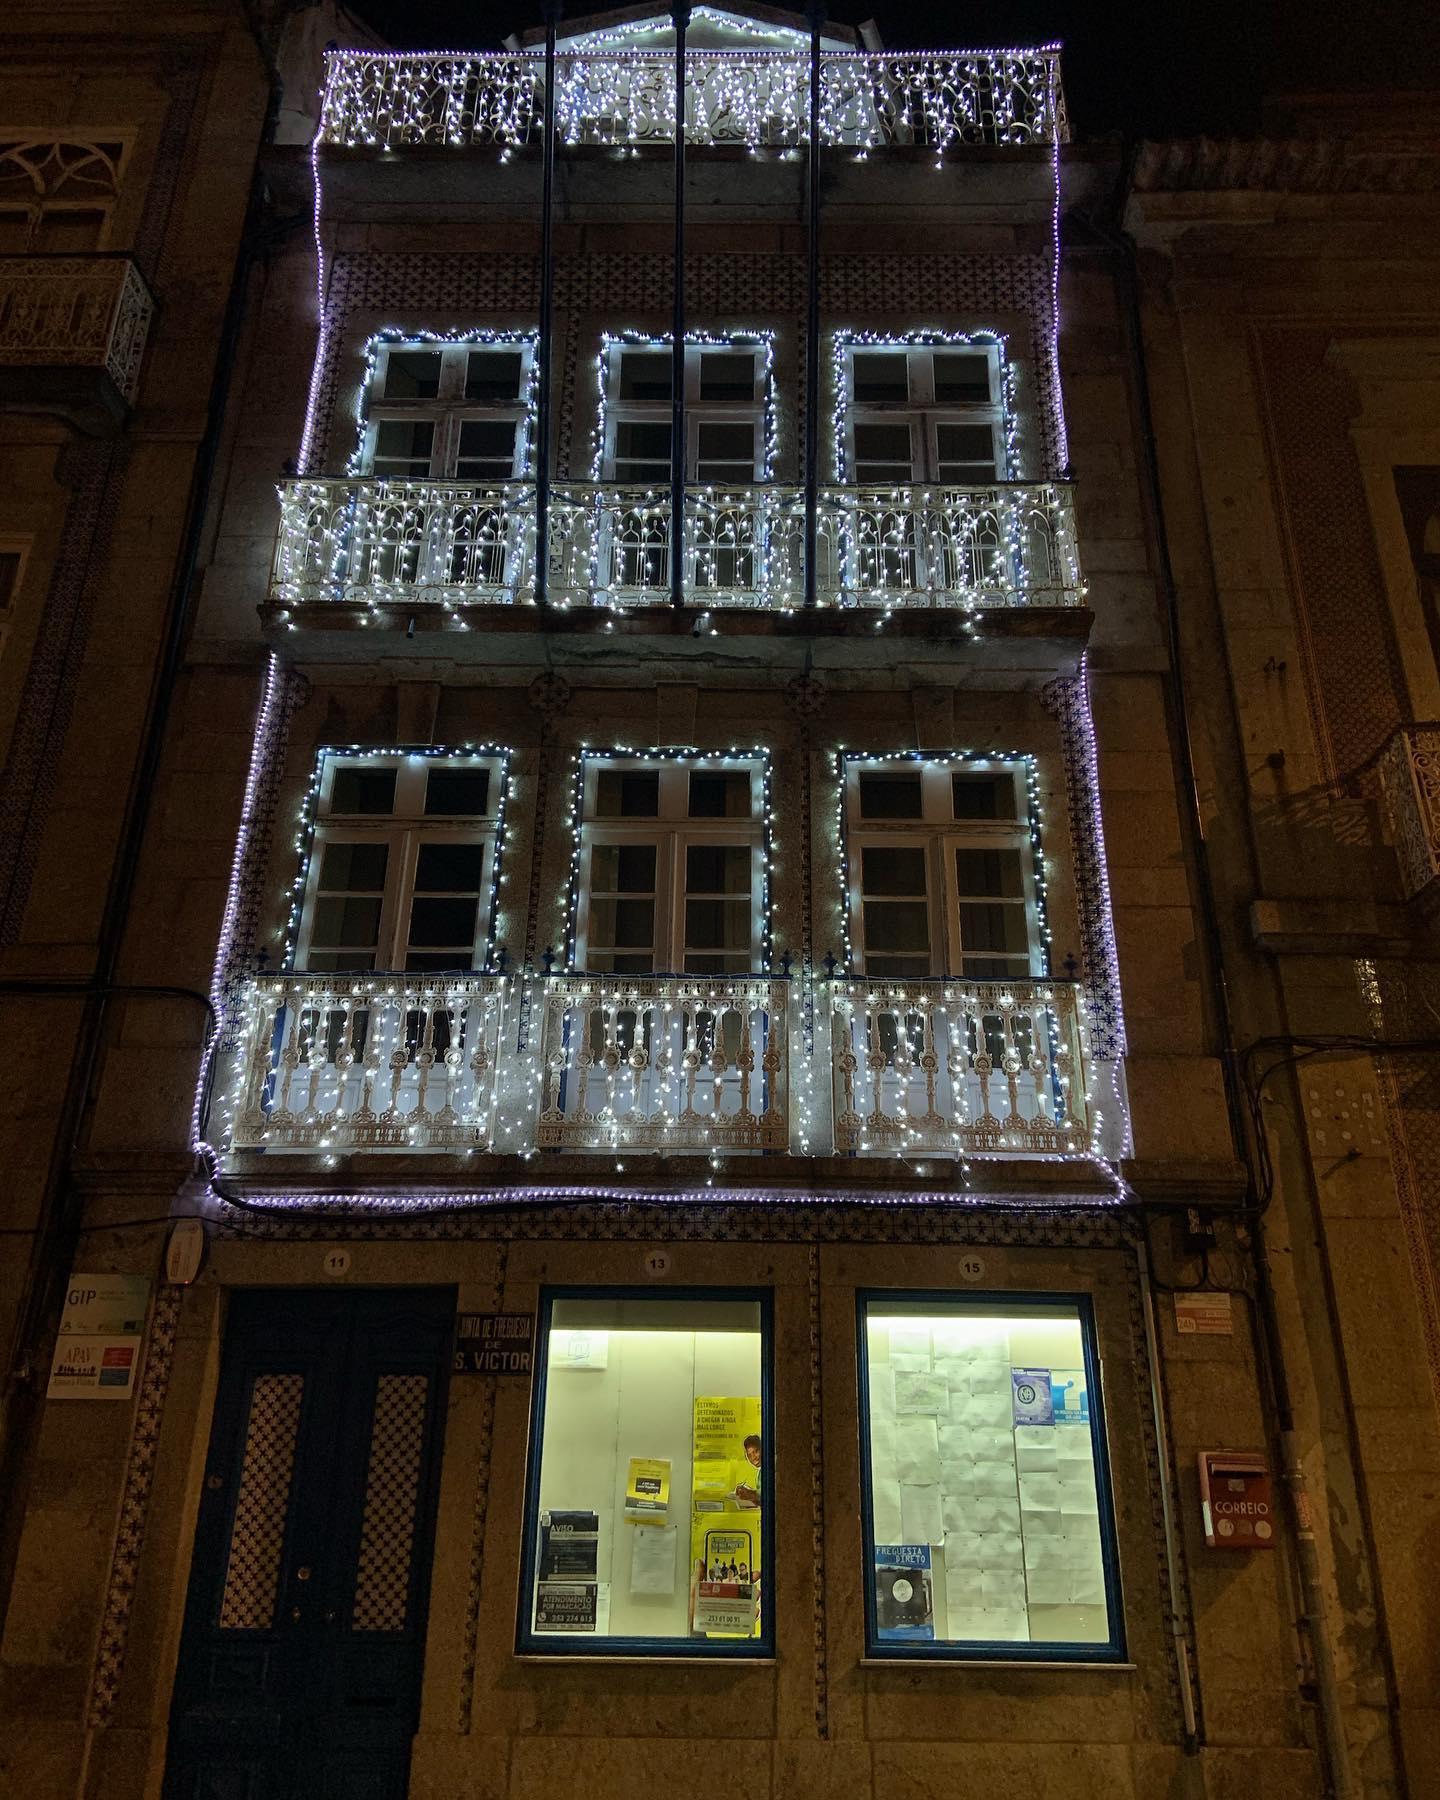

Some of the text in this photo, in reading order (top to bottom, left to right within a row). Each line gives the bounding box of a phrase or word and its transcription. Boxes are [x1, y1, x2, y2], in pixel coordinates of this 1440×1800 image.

[330, 1256, 344, 1268] 11
[650, 1258, 665, 1269] 13
[964, 1262, 980, 1273] 15
[68, 1288, 97, 1305] GIP
[482, 1319, 494, 1338] DE
[494, 1317, 530, 1338] FREGUESIA
[485, 1341, 504, 1350] DE
[455, 1351, 531, 1371] S. VICTOR
[1214, 1501, 1269, 1515] CORREIO
[551, 1524, 574, 1532] AVISO
[877, 1547, 923, 1555] FREGUESIA
[896, 1554, 926, 1563] DIRETO
[543, 1595, 592, 1604] ATENDIMENTO
